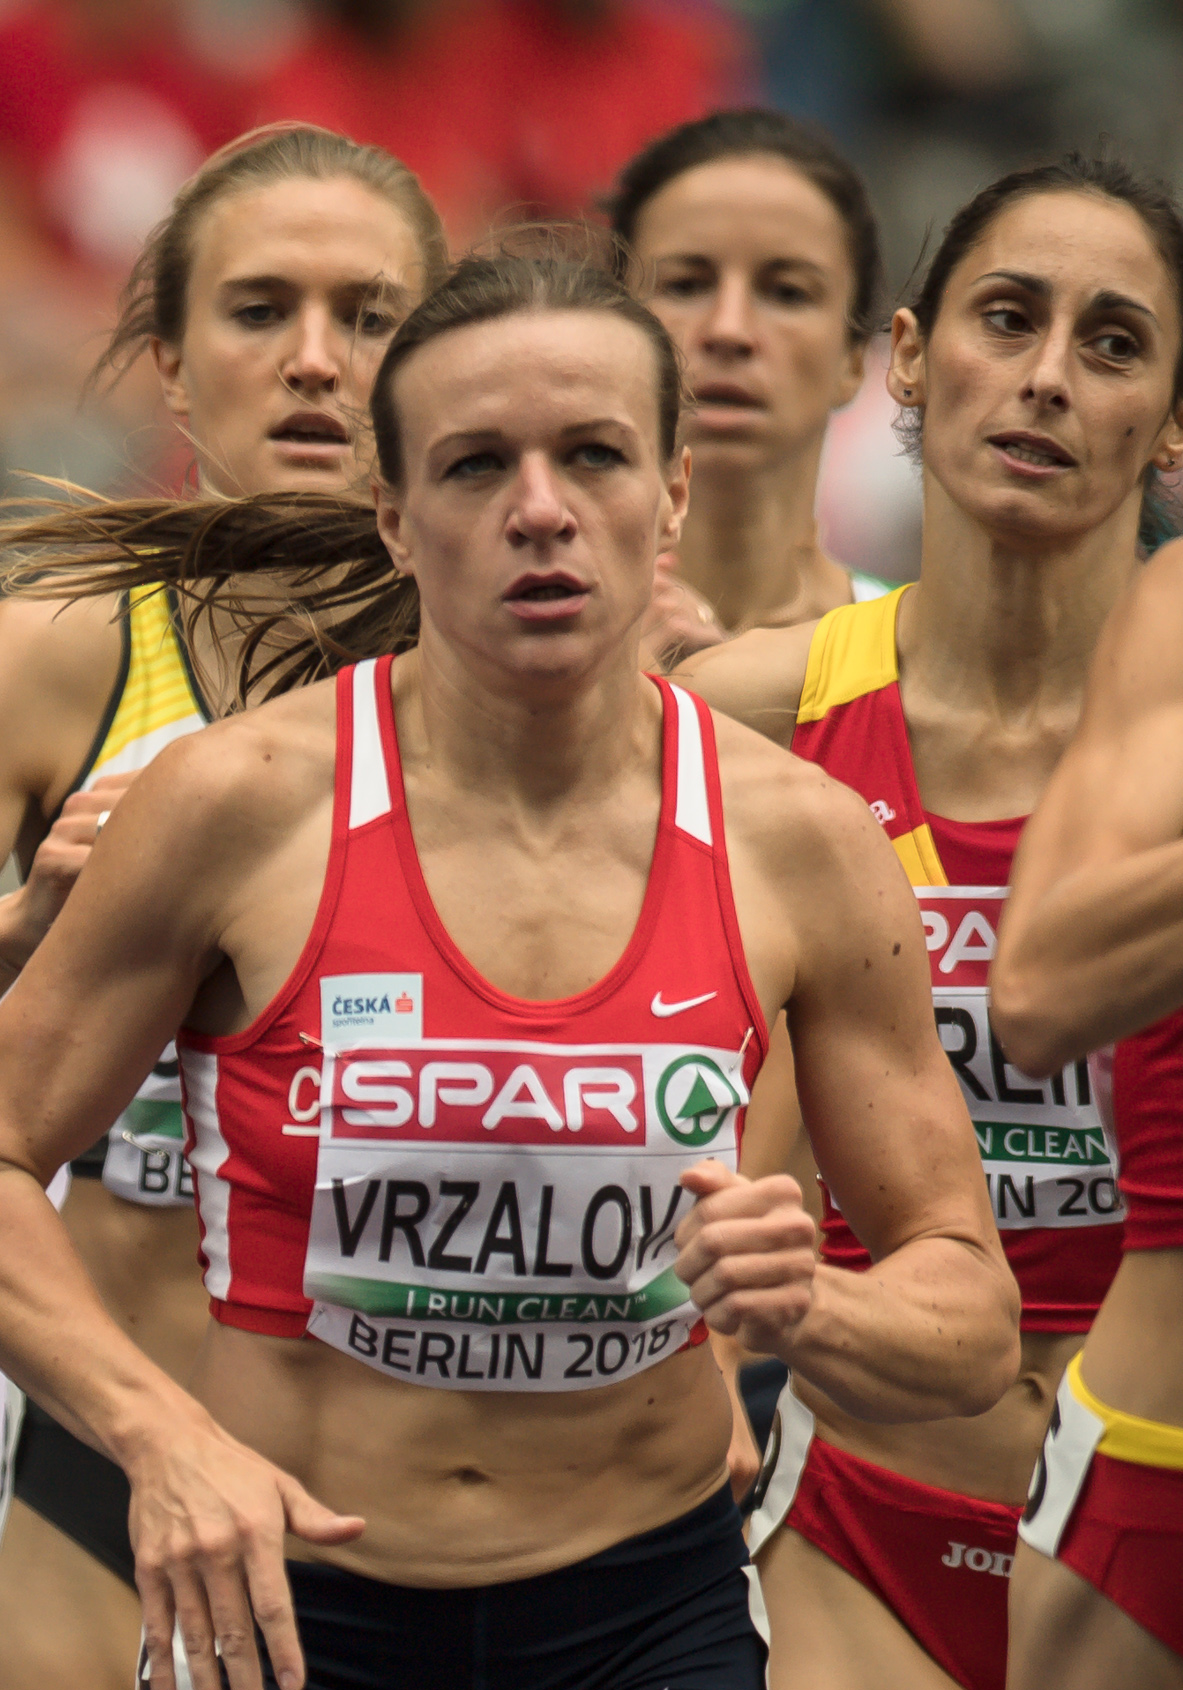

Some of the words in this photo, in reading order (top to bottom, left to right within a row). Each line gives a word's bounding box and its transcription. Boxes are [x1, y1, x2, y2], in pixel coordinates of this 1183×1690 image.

[920, 911, 997, 973] PA
[332, 993, 392, 1015] ČESKÁ
[341, 1060, 639, 1134] SPAR
[1056, 1177, 1119, 1217] 20
[407, 1290, 415, 1316] I
[427, 1292, 505, 1322] RUN
[347, 1314, 544, 1380] BERLIN
[563, 1319, 678, 1379] 2018
